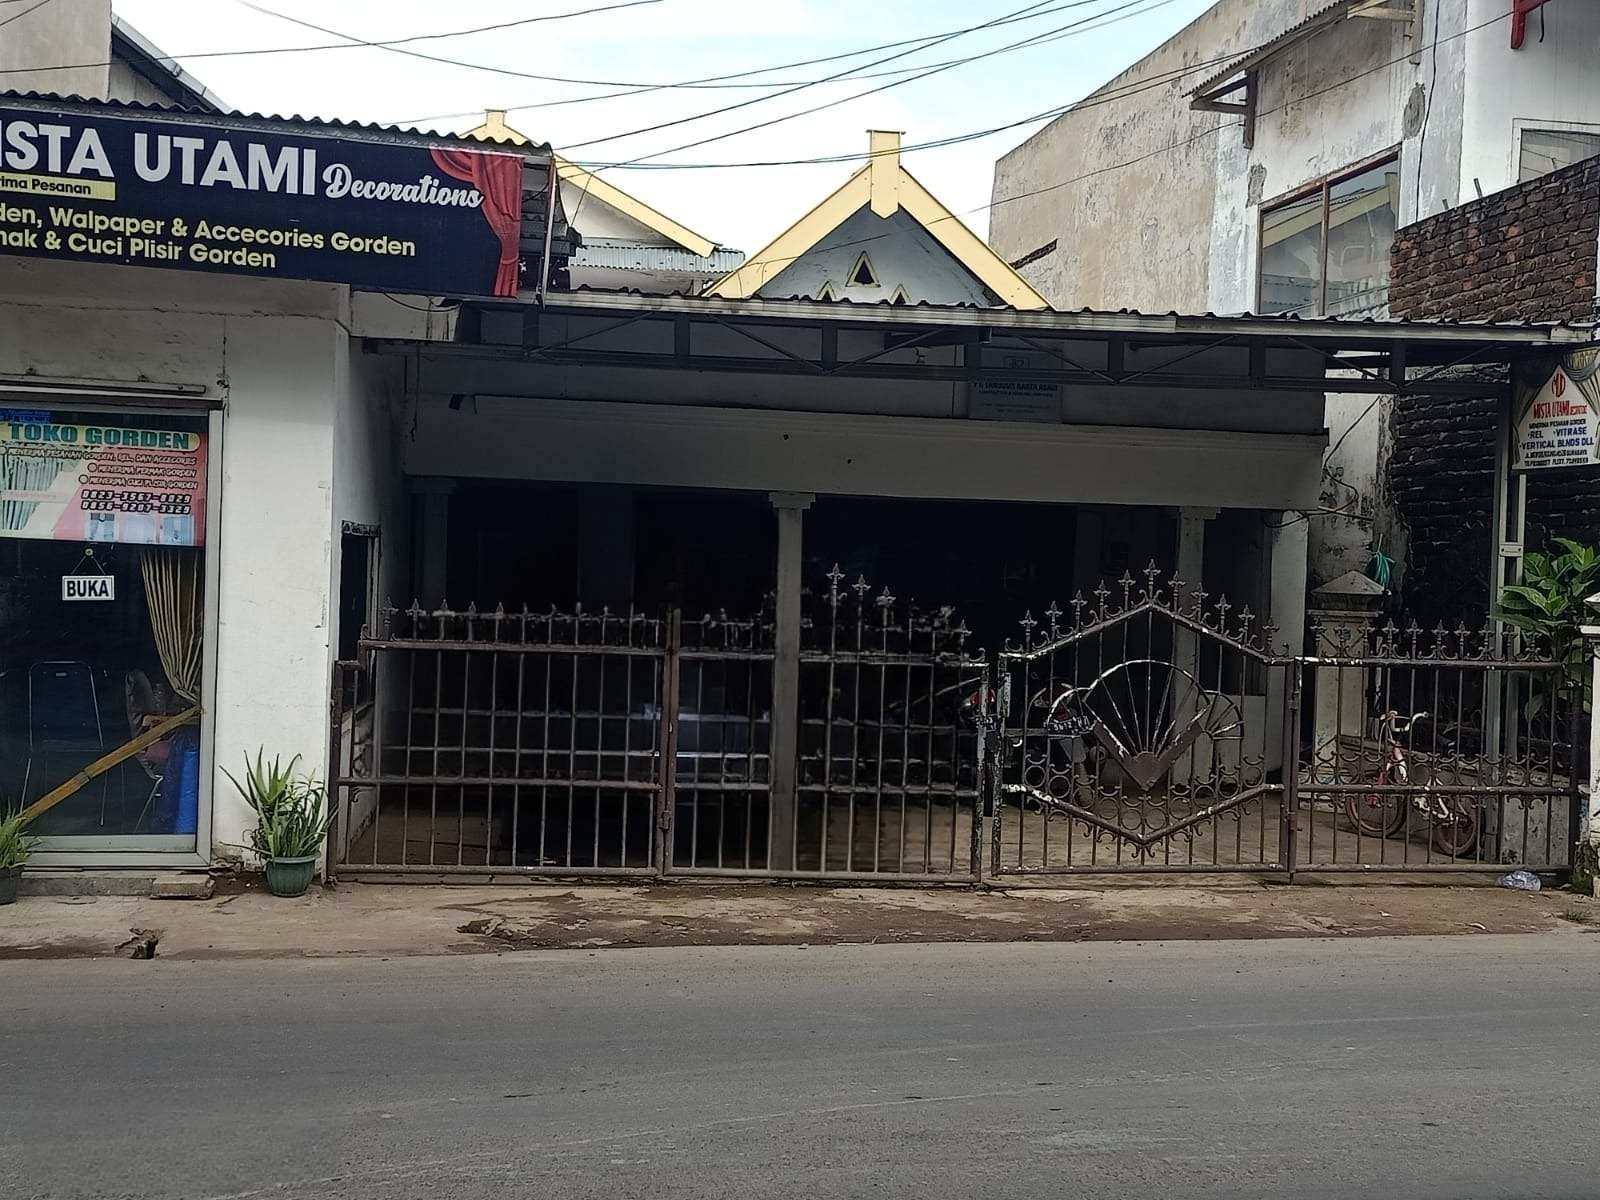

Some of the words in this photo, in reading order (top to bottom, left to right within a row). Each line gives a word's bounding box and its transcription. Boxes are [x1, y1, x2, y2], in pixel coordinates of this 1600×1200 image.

[0, 120, 115, 178] STA
[134, 132, 317, 196] UTAMI
[322, 163, 485, 209] Decorations
[0, 176, 28, 190] ima
[31, 178, 92, 195] Pesanan
[49, 206, 165, 236] Walpaper
[171, 217, 188, 237] &
[194, 219, 325, 249] Accecories
[331, 231, 417, 257] Gorden
[44, 230, 61, 250] &
[68, 232, 123, 255] Cuci
[130, 237, 183, 260] Plisir
[189, 243, 277, 269] Gorden
[1552, 400, 1570, 417] UTAMI
[8, 422, 78, 443] TOKO
[86, 428, 189, 449] GORDEN
[1556, 427, 1587, 437] VITRASE
[1521, 440, 1555, 450] VERTICAL
[1581, 437, 1594, 445] DLL
[136, 454, 153, 464] DAN
[66, 580, 110, 598] BUKA
